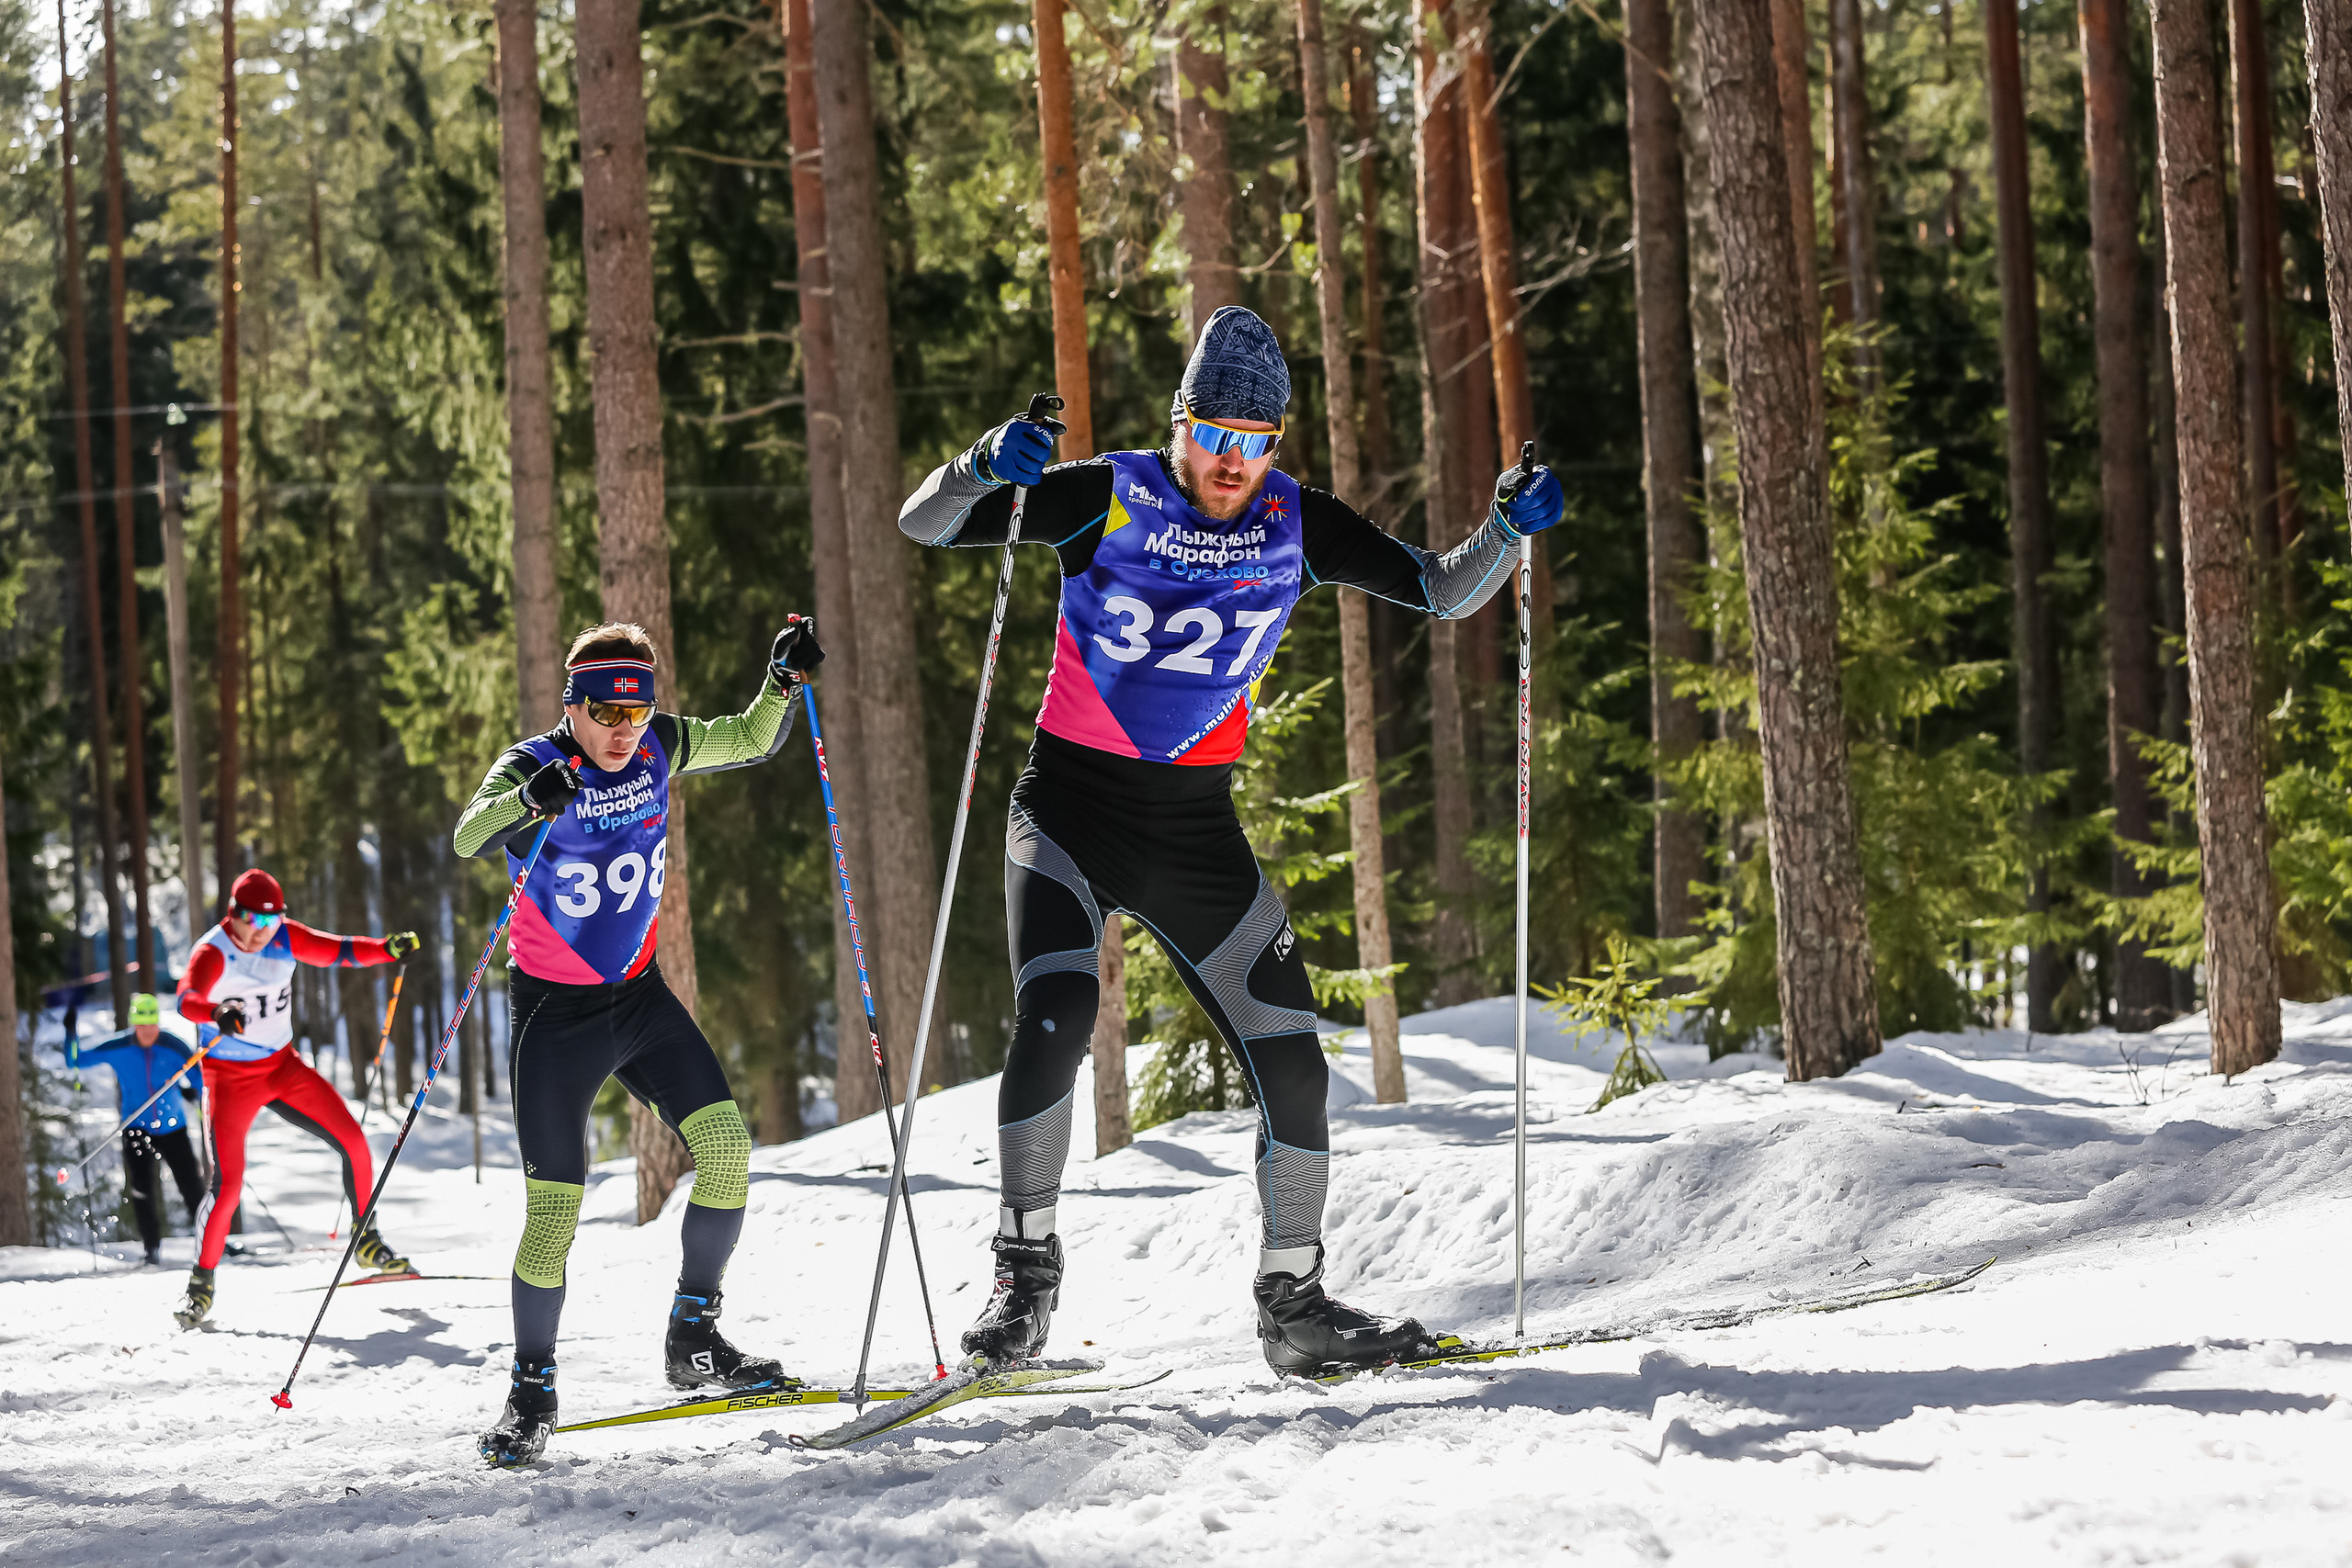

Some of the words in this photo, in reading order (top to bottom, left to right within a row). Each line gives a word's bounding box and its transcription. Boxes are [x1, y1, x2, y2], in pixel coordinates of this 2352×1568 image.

[1143, 532, 1261, 569] Марафон
[1163, 522, 1267, 547] Лыжный
[1148, 558, 1162, 570] в
[1170, 560, 1269, 581] Орехово
[1092, 595, 1283, 677] 327
[1166, 653, 1270, 760] www.multsprt.ru
[583, 769, 654, 804] Лыжный
[575, 788, 655, 820] Марафон
[583, 823, 594, 834] в
[598, 802, 662, 831] Орехово
[642, 814, 662, 829] 2022
[555, 836, 667, 919] 398
[222, 986, 291, 1020] 15
[431, 923, 505, 1071] TORNADO
[726, 1393, 804, 1410] FISCHER
